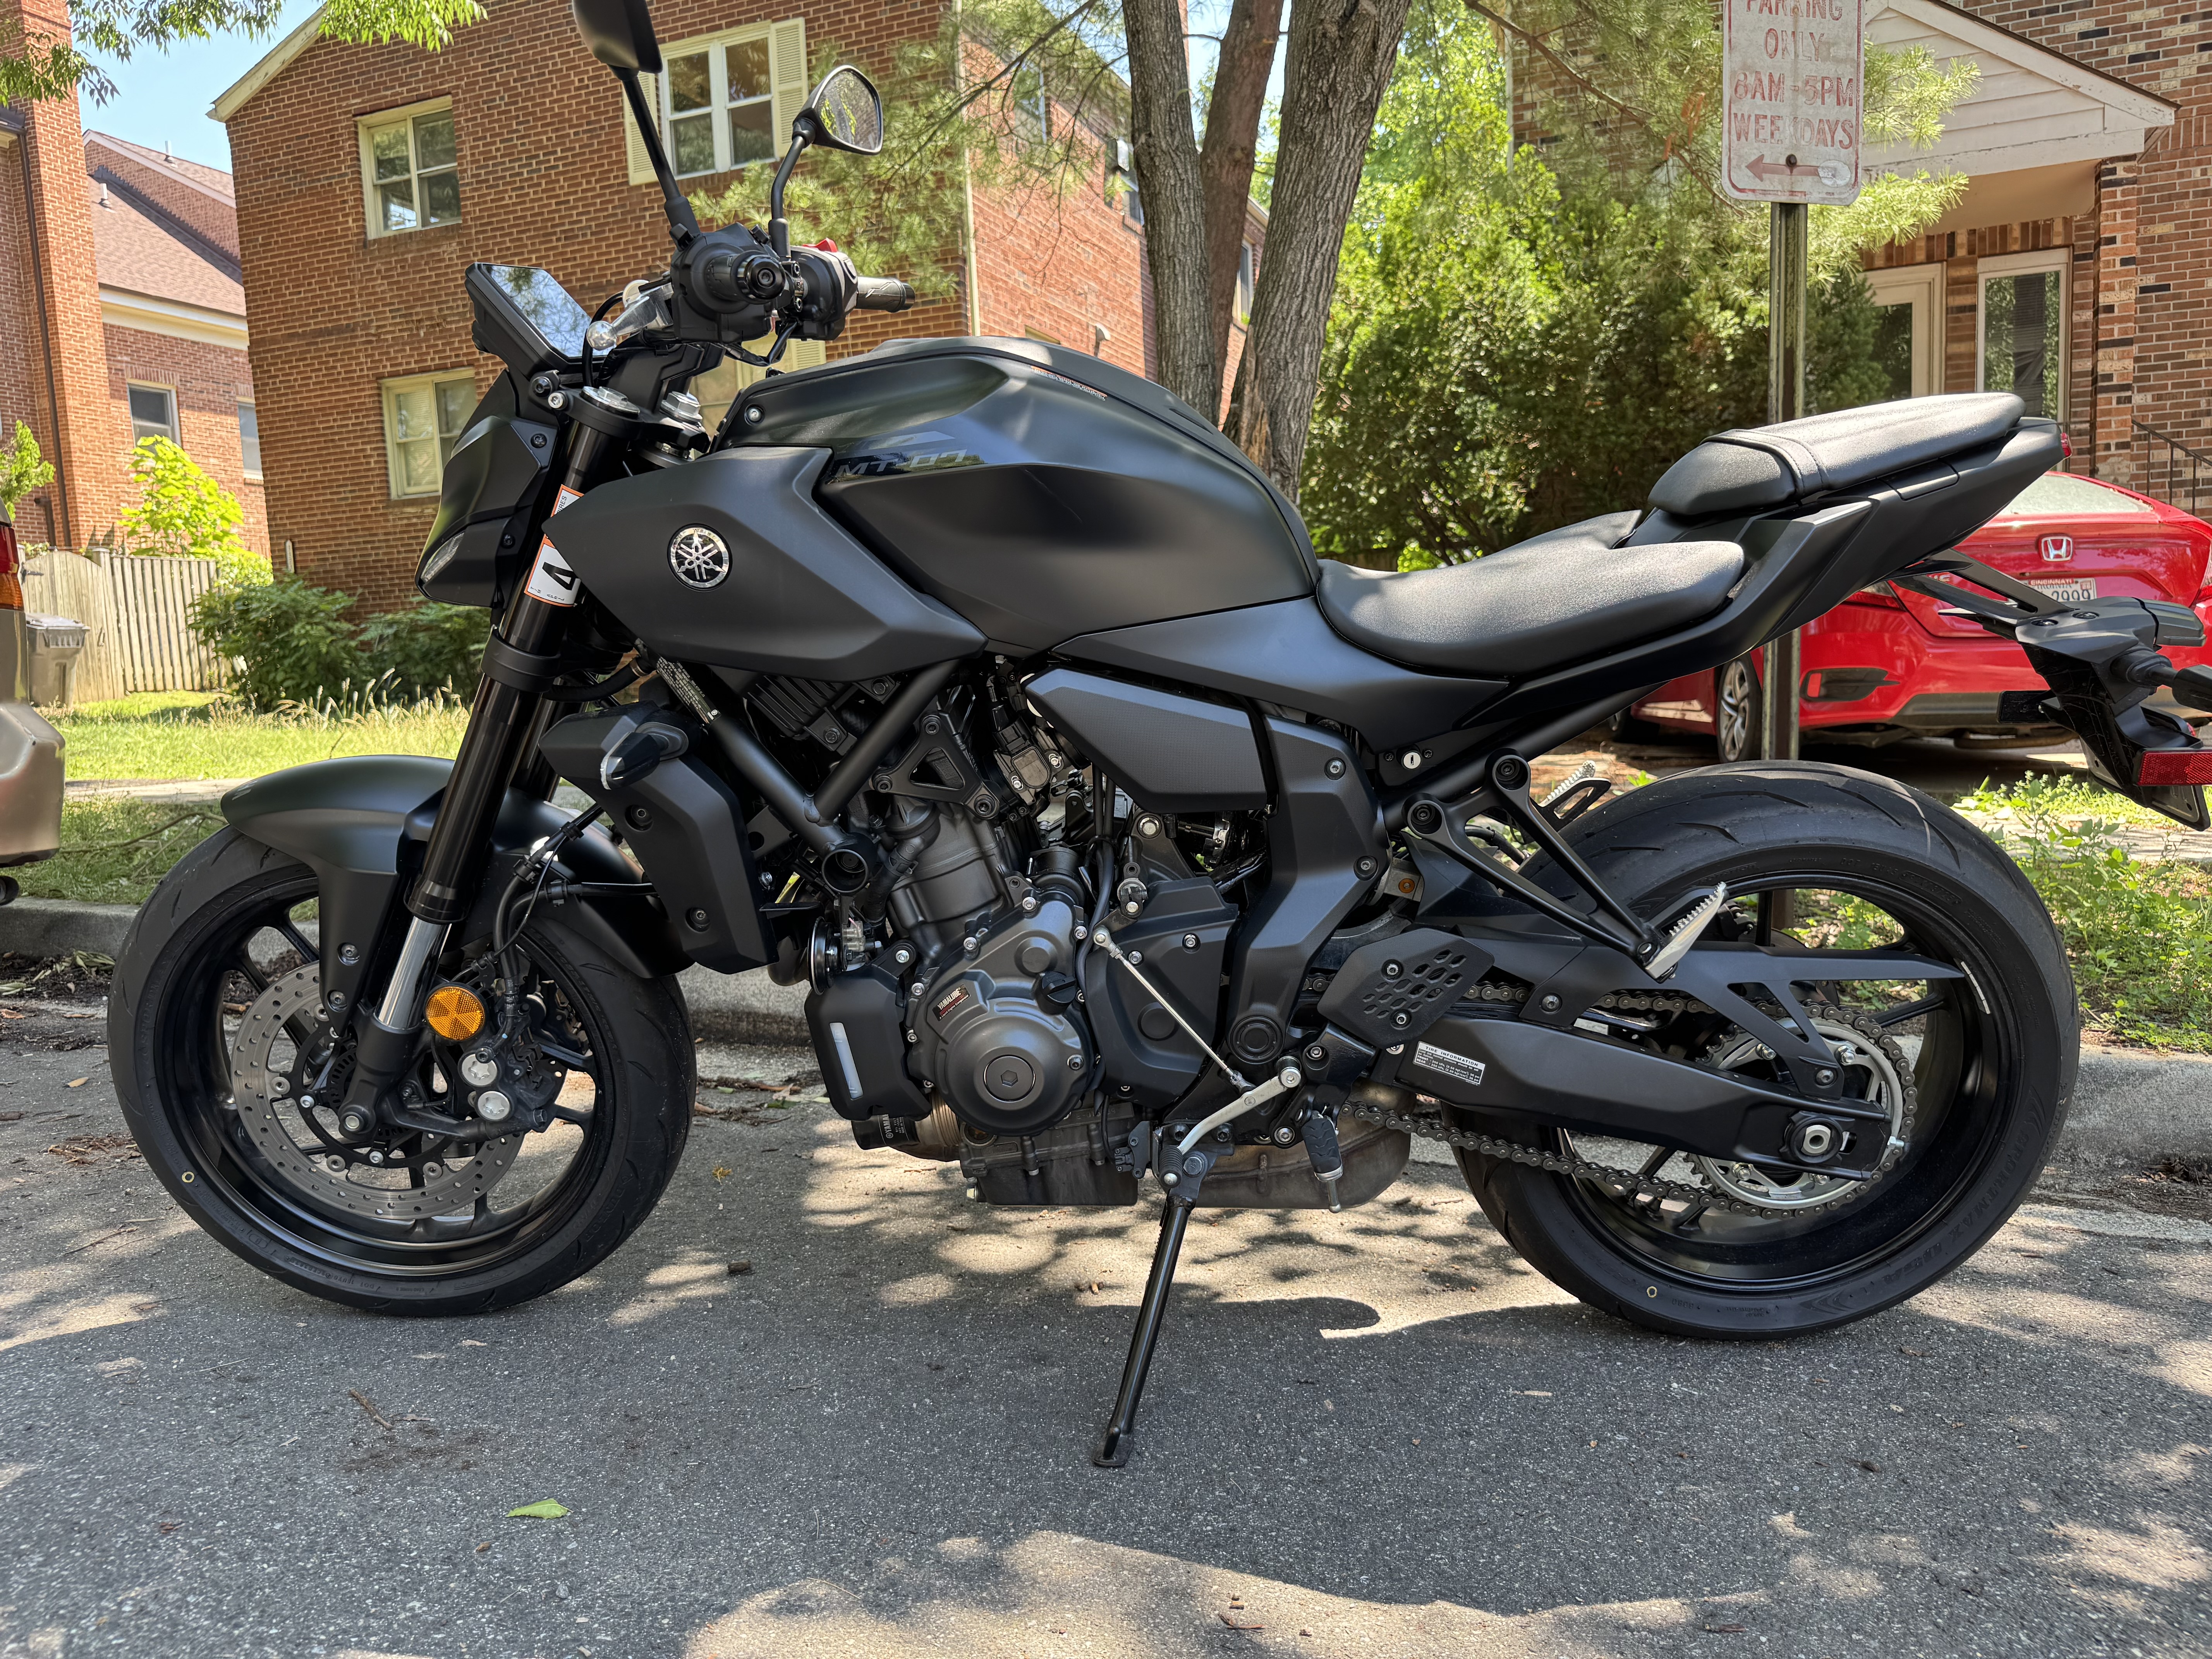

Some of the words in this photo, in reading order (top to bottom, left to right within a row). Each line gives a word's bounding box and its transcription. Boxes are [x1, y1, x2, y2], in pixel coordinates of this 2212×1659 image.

[1764, 28, 1825, 61] ONLY
[1733, 113, 1853, 149] WEEKDAYS
[835, 449, 967, 478] MT-07
[937, 988, 962, 1010] YAMALUBE
[1441, 1051, 1479, 1066] INFORMATION
